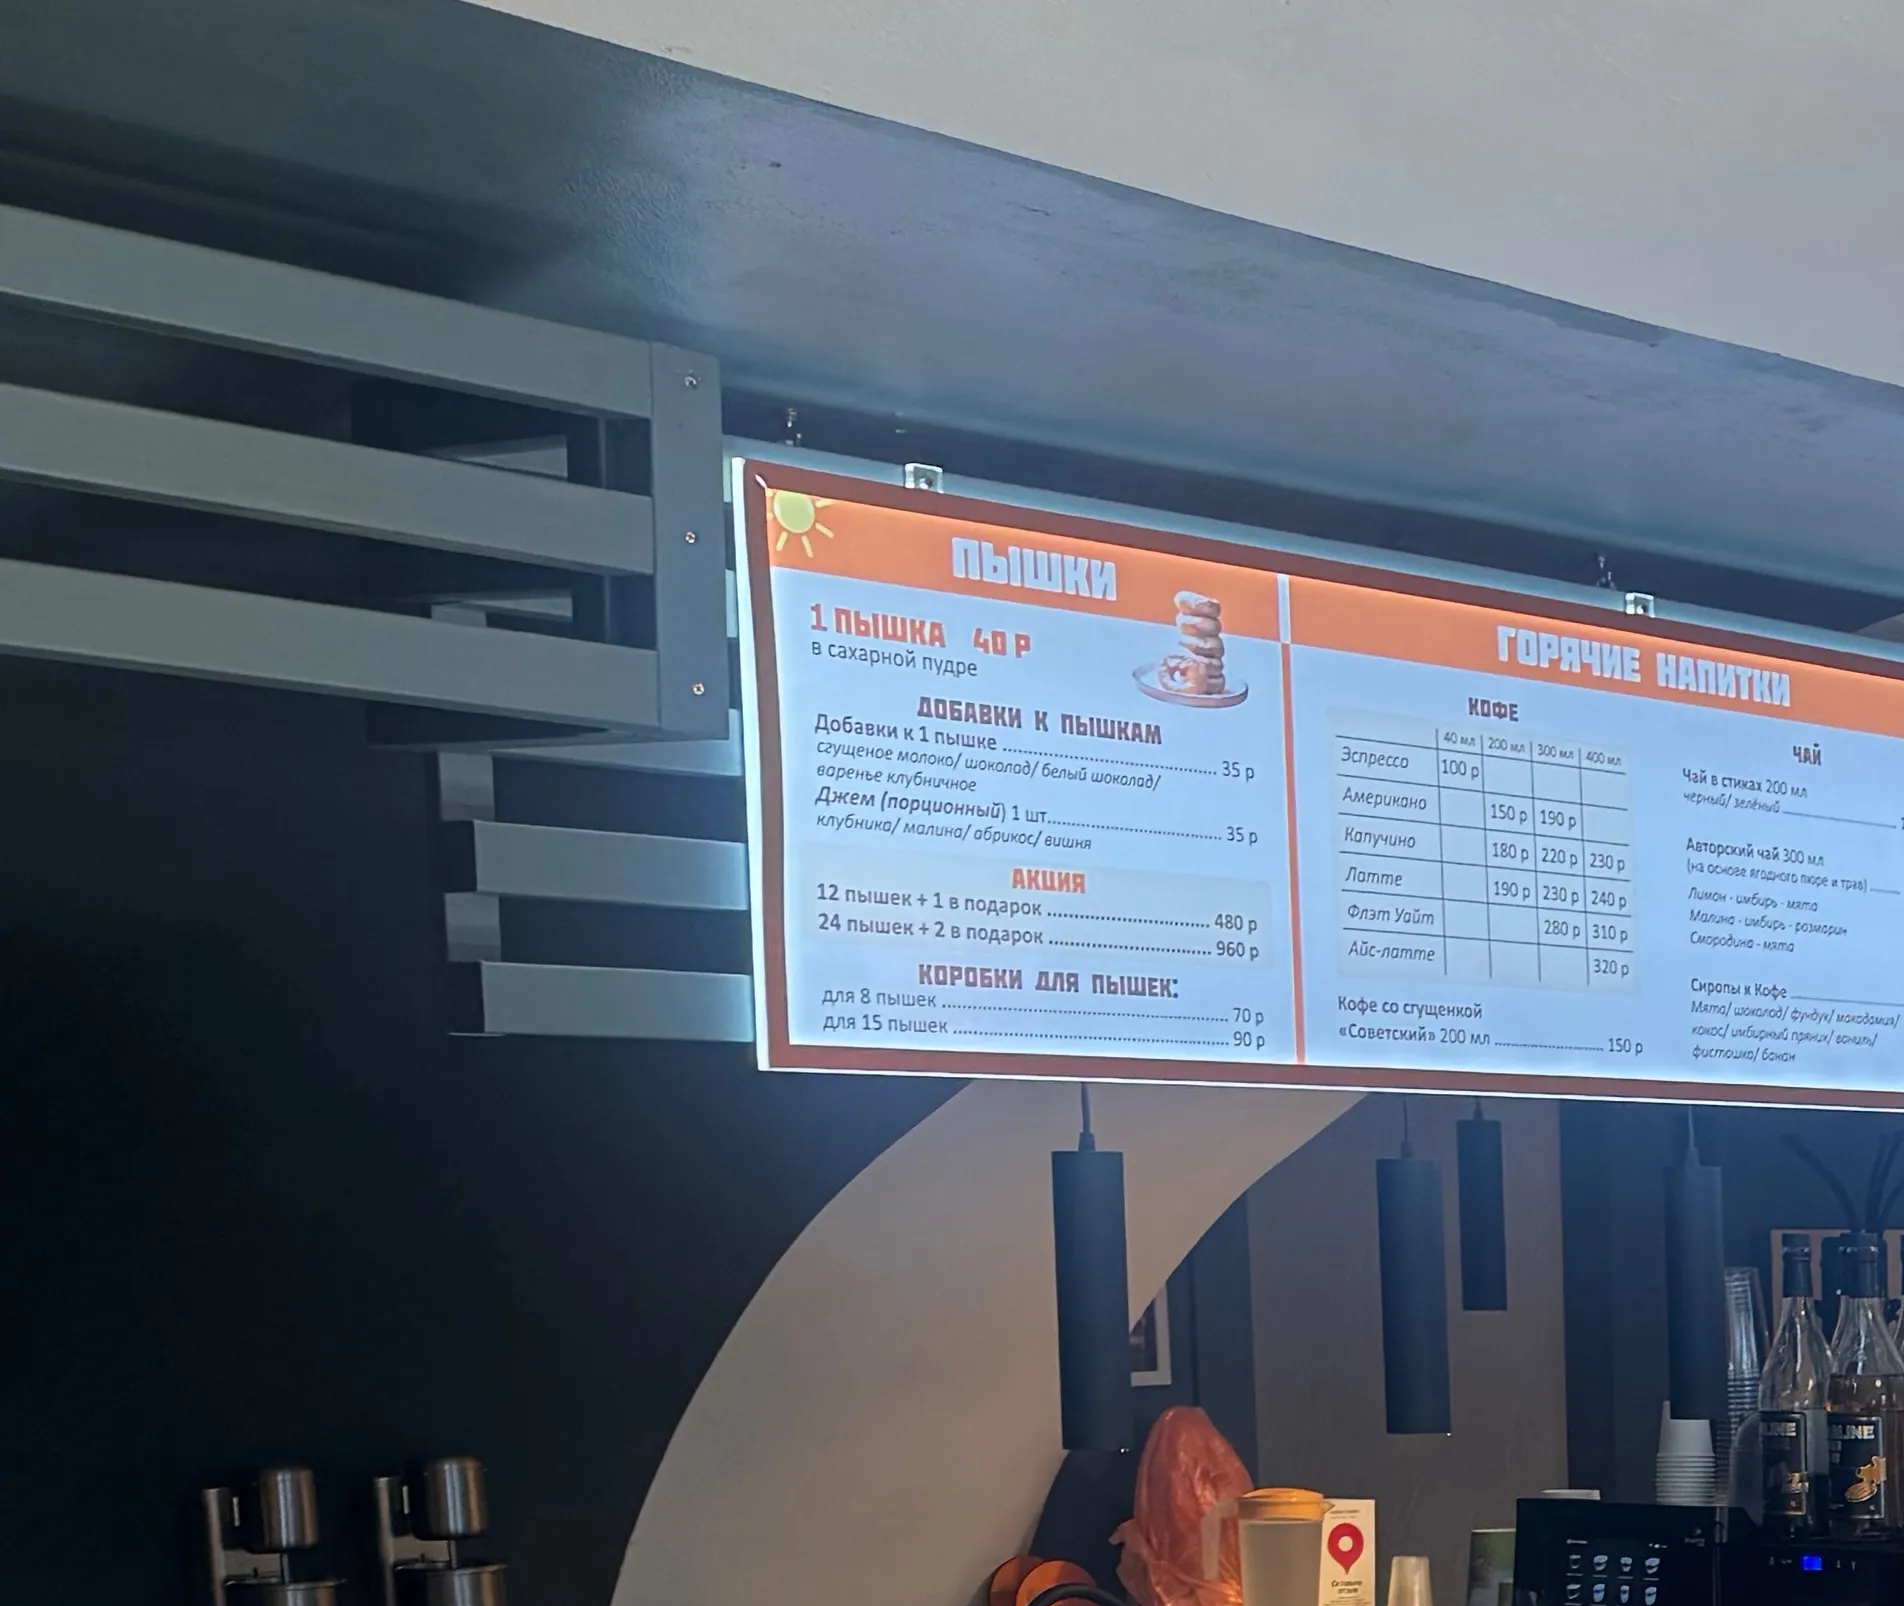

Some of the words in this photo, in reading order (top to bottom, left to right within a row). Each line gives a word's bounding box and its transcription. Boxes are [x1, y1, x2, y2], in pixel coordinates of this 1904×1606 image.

[952, 537, 1117, 601] ПЫШКИ
[811, 604, 827, 631] 1
[834, 608, 946, 648] ПЫШКА
[973, 628, 1006, 656] 40
[1014, 634, 1030, 658] Р
[828, 644, 916, 668] сахарной
[923, 657, 977, 678] пудре
[1497, 626, 1641, 683] ГОРЯЧИЕ
[917, 696, 1022, 728] ДОБАВКИ
[1035, 710, 1048, 732] К
[1061, 714, 1162, 744] ПЫШКАМ
[1468, 697, 1518, 722] КОФЕ
[815, 714, 898, 739] Добавки
[920, 726, 929, 742] 1
[935, 732, 996, 750] пышке
[1222, 761, 1240, 777] 35
[1246, 768, 1254, 782] р
[817, 742, 893, 760] сгущеное
[897, 751, 962, 770] молоко/
[965, 759, 1039, 778] шоколад/
[1042, 763, 1086, 780] белый
[1092, 772, 1161, 791] шоколад/
[1342, 746, 1408, 768] Эспрессо
[1442, 759, 1466, 776] 100
[1471, 766, 1479, 780] р
[817, 765, 883, 782] варенье
[887, 772, 976, 792] клубничное
[815, 786, 875, 806] Джем
[881, 791, 1006, 822] (порционный)
[1012, 805, 1020, 820] 1
[1227, 826, 1244, 842] 35
[1249, 832, 1258, 846] р
[1342, 787, 1426, 810] Американо
[1491, 804, 1515, 820] 150
[1520, 810, 1527, 824] р
[1540, 810, 1564, 826] 190
[1568, 816, 1576, 831] р
[817, 814, 901, 835] клубника/
[903, 823, 972, 840] малина/
[974, 826, 1042, 847] абрикос/
[1045, 836, 1091, 849] вишня
[1345, 827, 1416, 848] Капучино
[1493, 842, 1516, 858] 180
[1521, 848, 1528, 863] р
[1542, 848, 1566, 864] 220
[1570, 854, 1578, 868] р
[1590, 853, 1613, 869] 230
[1617, 860, 1625, 873] р
[1012, 868, 1085, 894] АКЦИЯ
[1345, 866, 1402, 886] Латте
[1494, 881, 1518, 897] 190
[1523, 887, 1530, 901] р
[1543, 886, 1567, 902] 230
[1572, 892, 1579, 906] р
[1592, 890, 1615, 906] 240
[1619, 897, 1626, 910] р
[818, 884, 839, 900] 12
[846, 890, 912, 906] пышек
[934, 892, 943, 908] 1
[965, 898, 1041, 918] подарок
[1215, 914, 1243, 930] 480
[1248, 920, 1257, 934] р
[1348, 904, 1390, 921] Флэт
[1395, 908, 1434, 924] Уайт
[1544, 920, 1568, 936] 280
[1573, 926, 1580, 940] р
[1593, 924, 1616, 940] 310
[1620, 930, 1628, 944] р
[818, 913, 841, 930] 24
[848, 919, 914, 935] пышек
[934, 921, 945, 937] 2
[967, 927, 1043, 946] подарок
[1216, 941, 1245, 957] 960
[1250, 947, 1259, 961] р
[1348, 940, 1435, 961] Айс-латте
[1594, 959, 1617, 974] 320
[1621, 965, 1629, 978] р
[919, 964, 1022, 990] КОРОБКИ
[1035, 972, 1079, 992] ДЛЯ
[1092, 974, 1178, 998] ПЫШЕК:
[822, 990, 854, 1006] для
[860, 988, 871, 1004] 8
[876, 993, 936, 1007] пышек
[1233, 1008, 1251, 1023] 70
[1256, 1012, 1264, 1026] р
[1338, 996, 1377, 1016] Кофе
[1382, 1002, 1398, 1013] со
[1403, 1003, 1482, 1019] сгущенкой
[823, 1016, 856, 1032] для
[862, 1014, 882, 1030] 15
[888, 1019, 948, 1033] пышек
[1234, 1031, 1252, 1046] 90
[1256, 1036, 1265, 1050] р
[1440, 1028, 1466, 1044] 200
[1470, 1034, 1490, 1045] мл
[1609, 1038, 1631, 1053] 150
[1636, 1043, 1643, 1056] р
